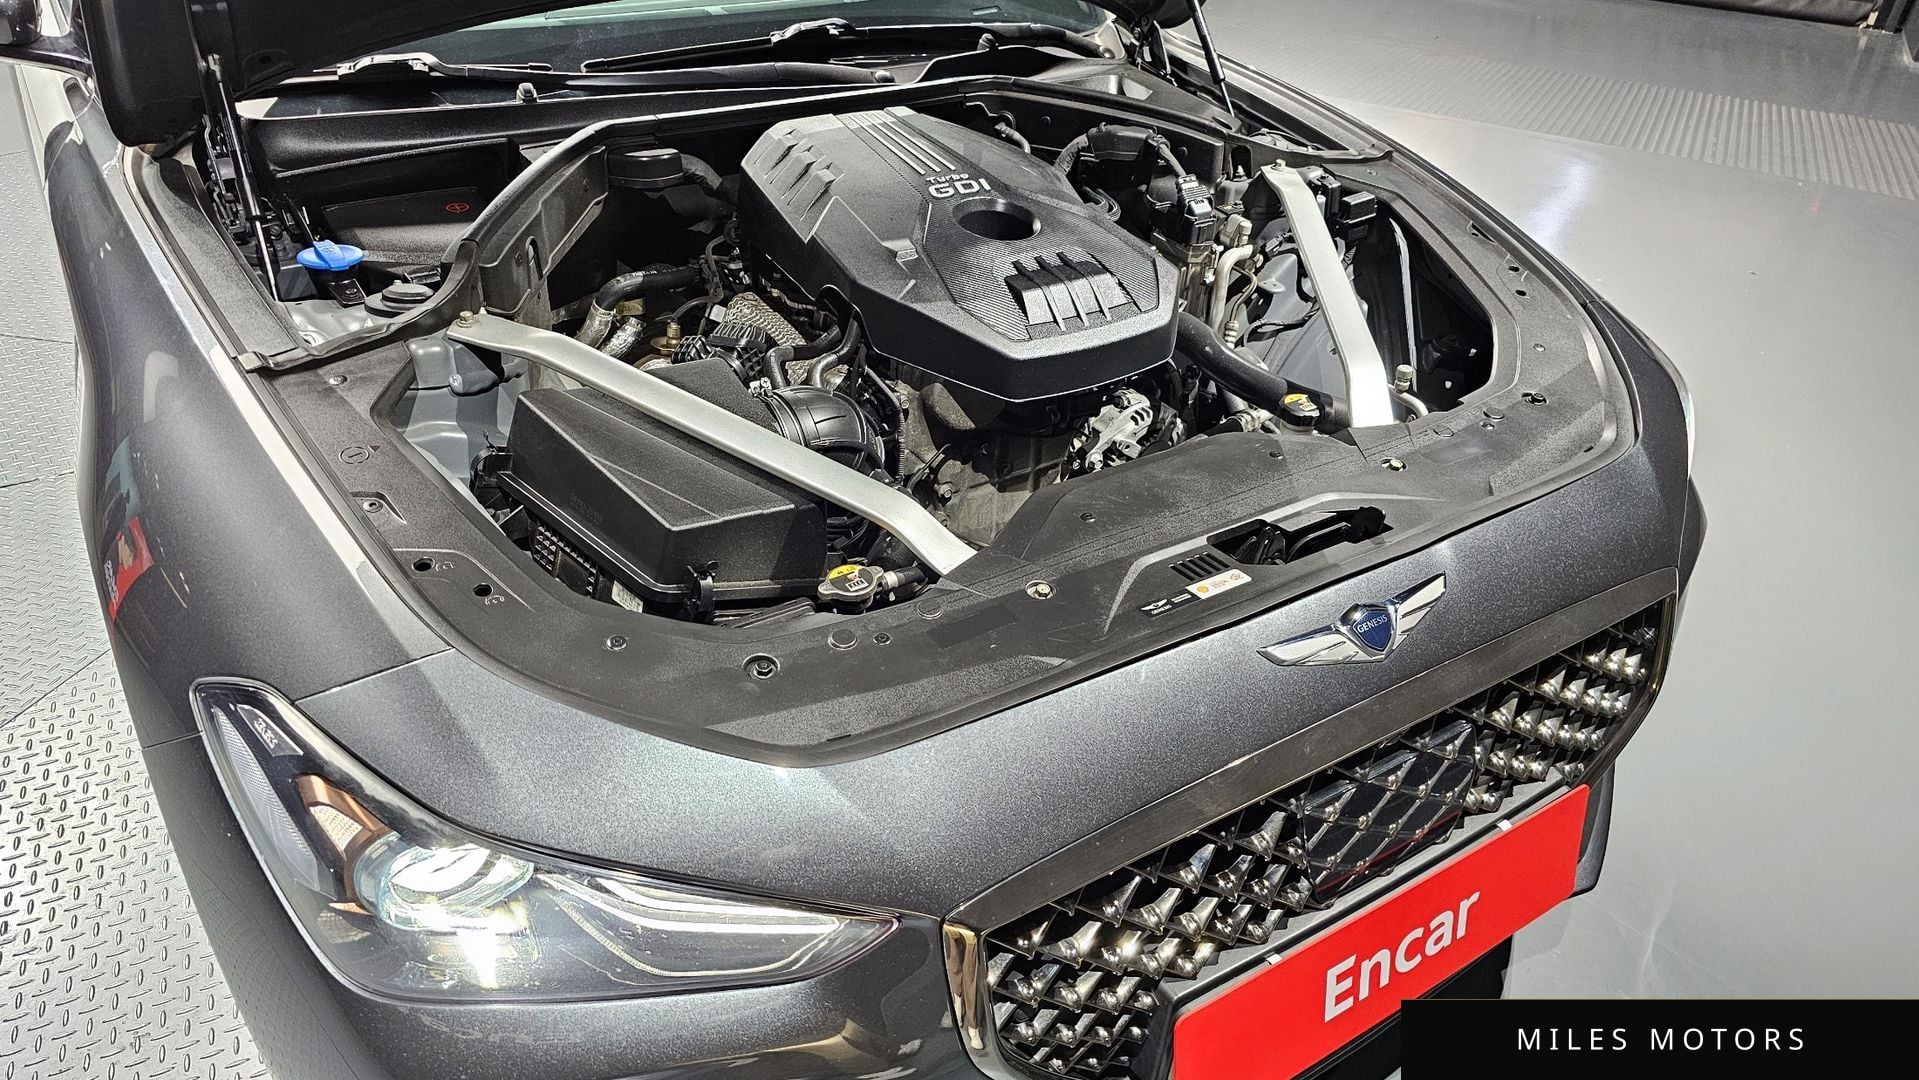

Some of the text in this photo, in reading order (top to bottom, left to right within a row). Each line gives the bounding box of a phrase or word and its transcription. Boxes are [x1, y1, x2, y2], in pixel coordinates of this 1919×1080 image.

[925, 173, 970, 184] Turbo
[928, 178, 992, 198] GDI
[1357, 614, 1388, 633] GENESIS
[1324, 891, 1481, 1024] Encar
